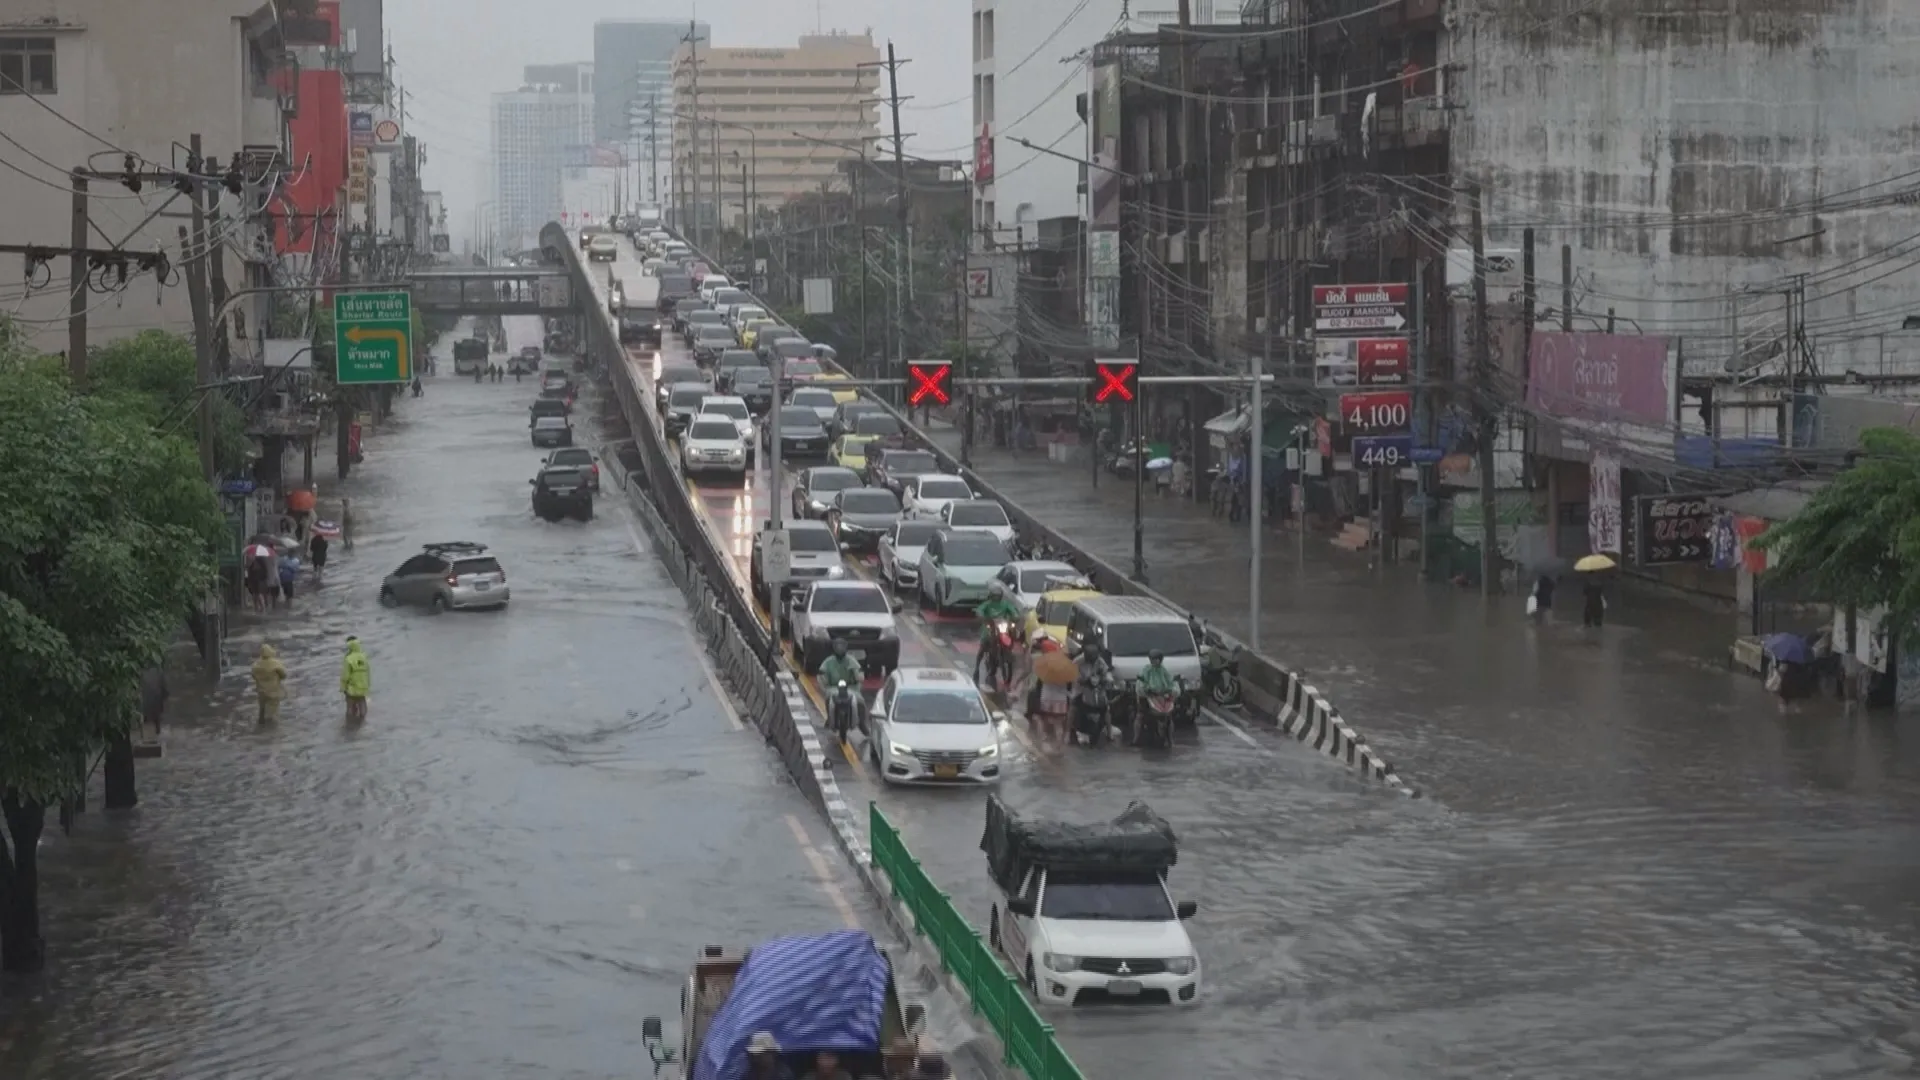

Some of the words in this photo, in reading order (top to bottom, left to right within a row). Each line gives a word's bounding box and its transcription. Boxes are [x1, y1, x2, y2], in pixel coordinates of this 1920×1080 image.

[341, 295, 403, 310] เส้นทางลัด
[1321, 307, 1351, 317] BUDDY
[1354, 306, 1394, 317] MANSION
[347, 346, 391, 361] หัวหมาก
[1349, 404, 1406, 432] 4,100
[1361, 446, 1406, 466] 449-
